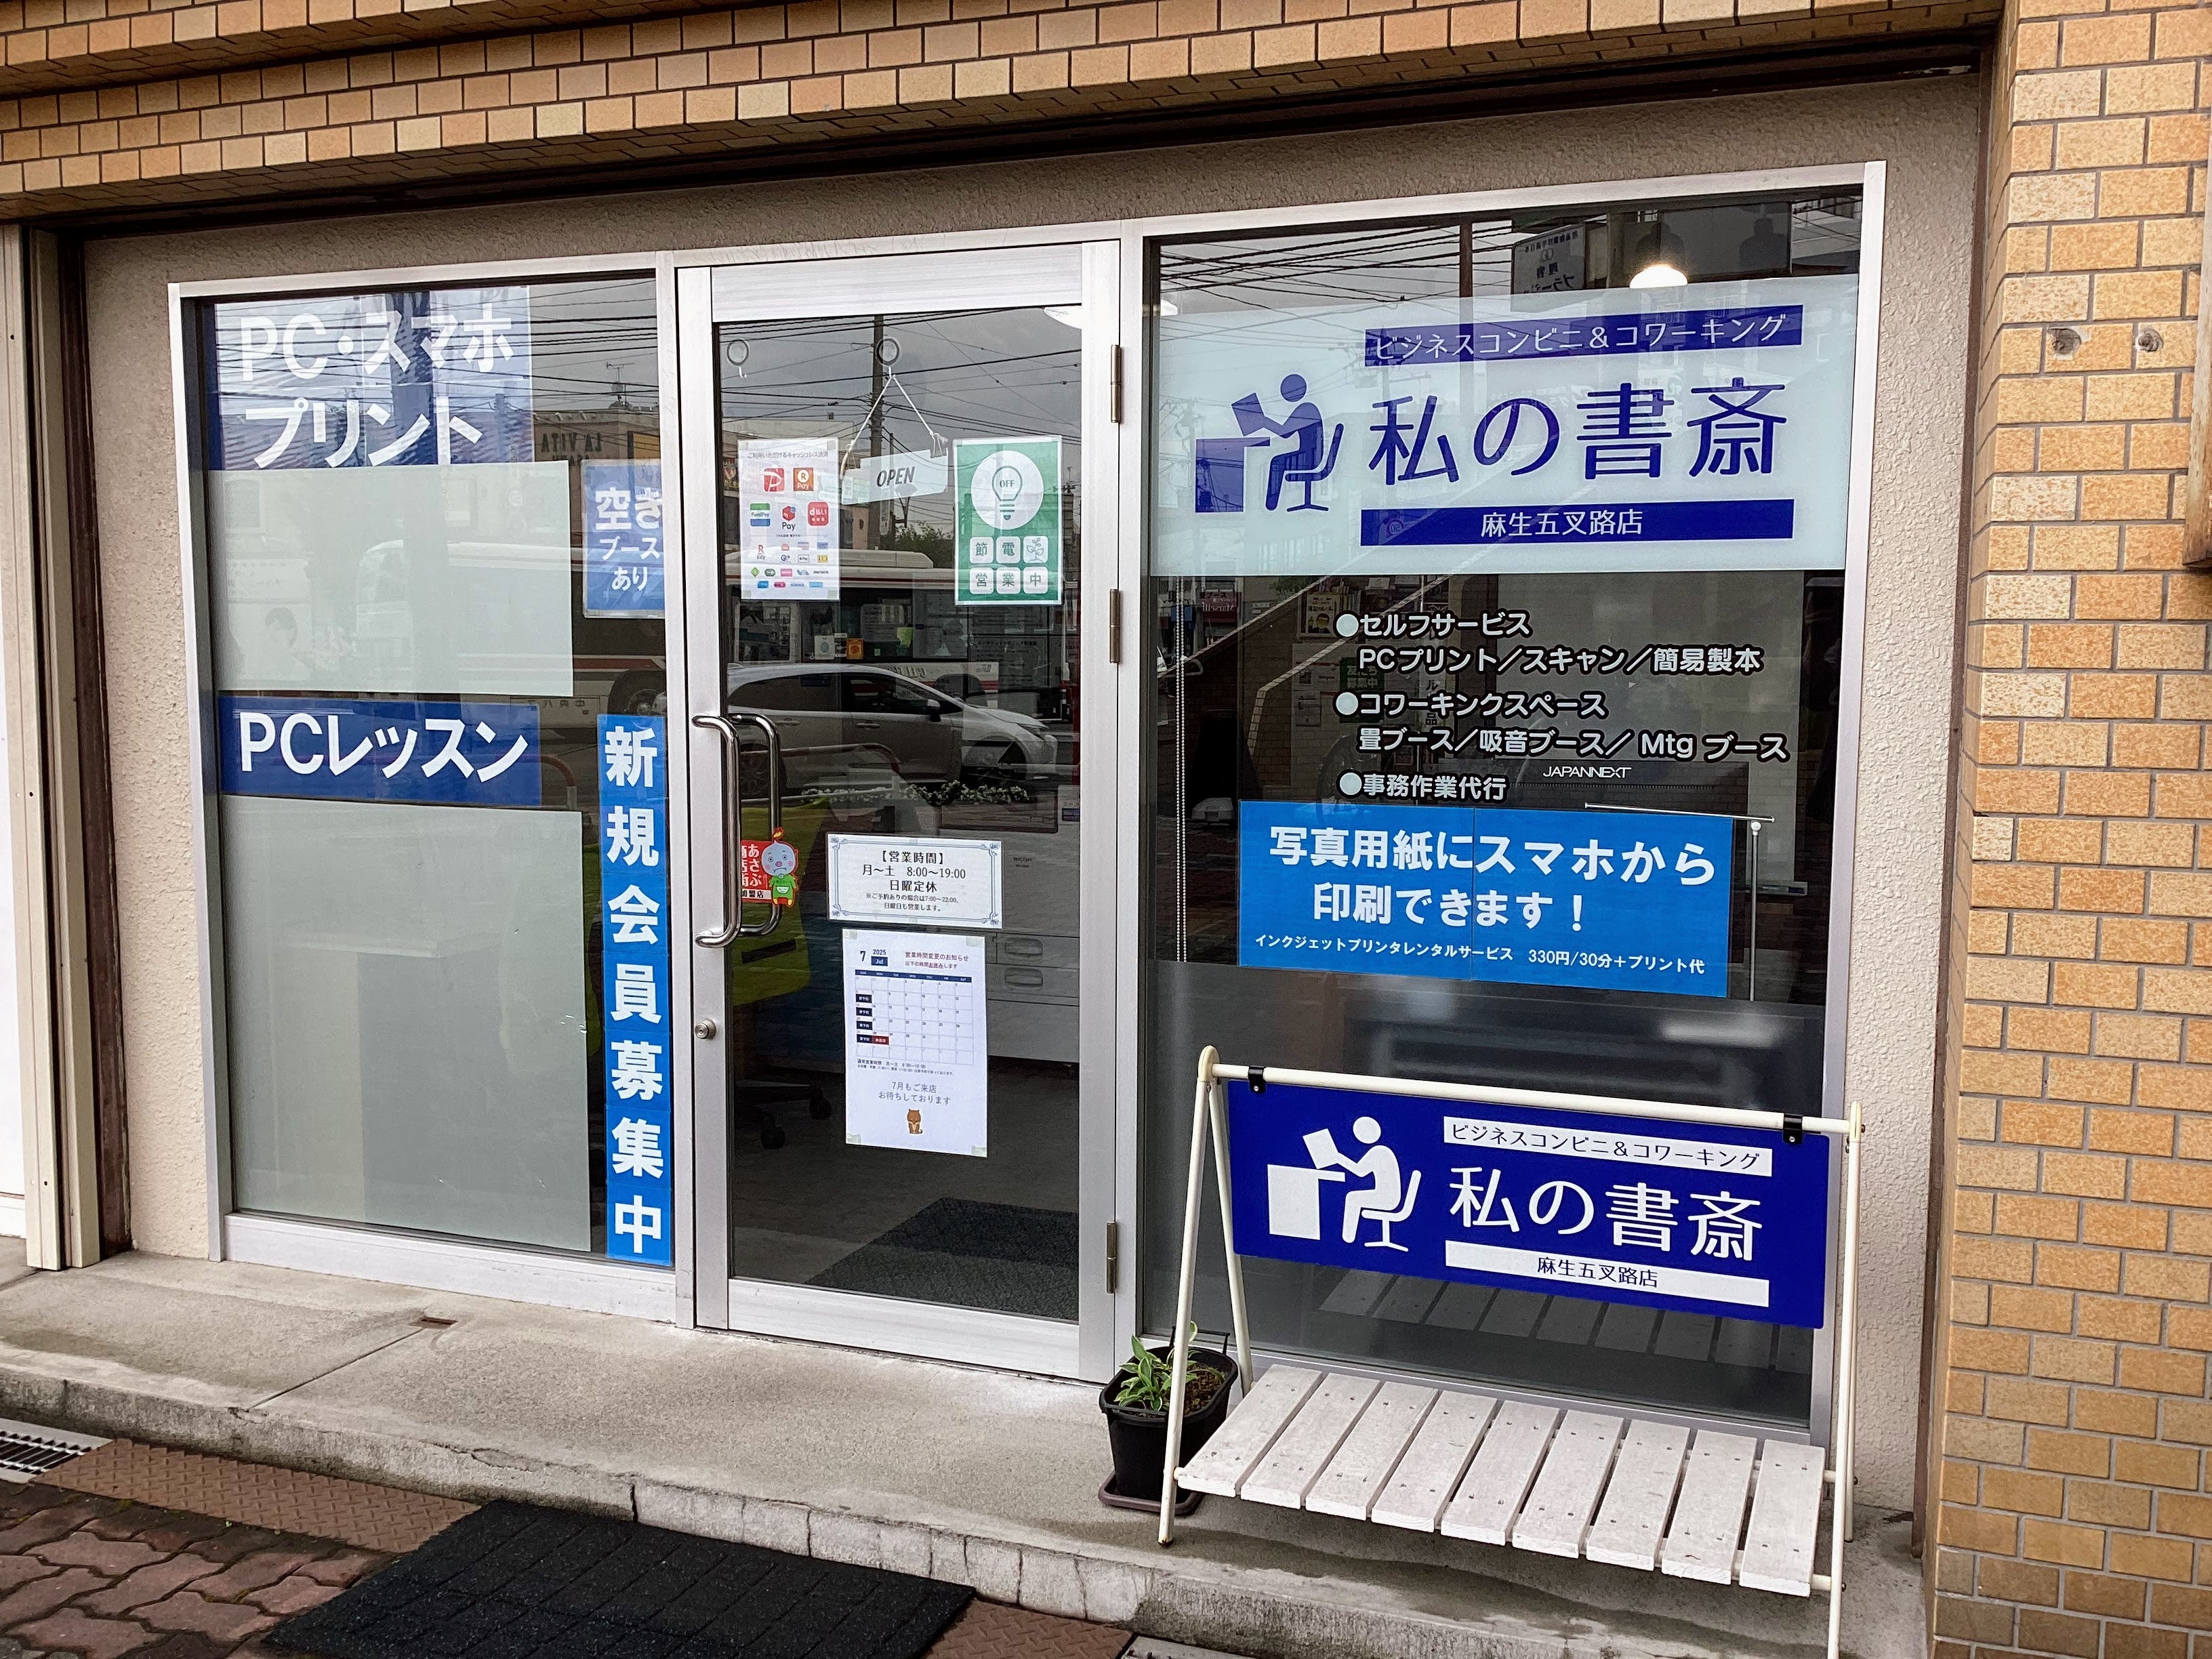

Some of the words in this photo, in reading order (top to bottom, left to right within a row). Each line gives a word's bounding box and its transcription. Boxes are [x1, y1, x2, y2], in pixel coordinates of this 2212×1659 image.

[240, 303, 514, 382] PC・スマホ
[1374, 316, 1787, 360] ビジネスコンビニ＆コワーキング
[245, 395, 483, 468] プリント
[1368, 377, 1789, 485] 私の書斎
[876, 466, 916, 487] OPEN
[1000, 479, 1015, 488] OFF
[596, 487, 662, 530] 空き
[782, 522, 796, 531] Pay
[1481, 508, 1643, 538] 麻生五叉路店
[602, 537, 661, 561] ブース
[975, 542, 1015, 556] 節電
[611, 567, 647, 590] あり
[976, 573, 1041, 588] 営業中
[1359, 613, 1530, 638] セルフサービス
[1359, 647, 1762, 672] PCプリント／スキャン／簡易製本
[240, 713, 528, 783] PCレッスン
[1641, 734, 1693, 759] Mtg
[1705, 736, 1789, 760] ブース
[1542, 766, 1632, 779] JAPANNEXT
[1363, 773, 1507, 802] 事務作業代行
[748, 844, 762, 887] あさぶ
[881, 851, 944, 865] 【営業時間】
[1269, 826, 1715, 885] 写真用紙にスマホから
[889, 880, 938, 893] 日曜定休
[1313, 882, 1582, 932] 印刷できます！
[859, 951, 866, 962] 7
[905, 951, 969, 962] 営業時間変更のお知らせ
[1255, 934, 1514, 961] インクジェットプリンタレンタルサービス
[605, 725, 665, 1256] 新規会員募集中
[878, 1091, 951, 1105] お待ちしております
[892, 1082, 937, 1094] 7月もご来店
[1452, 1124, 1760, 1170] ビジネスコンビニ＆コワーキング
[1449, 1166, 1763, 1262] 私の書斎
[1537, 1256, 1658, 1289] 麻生五叉路店
